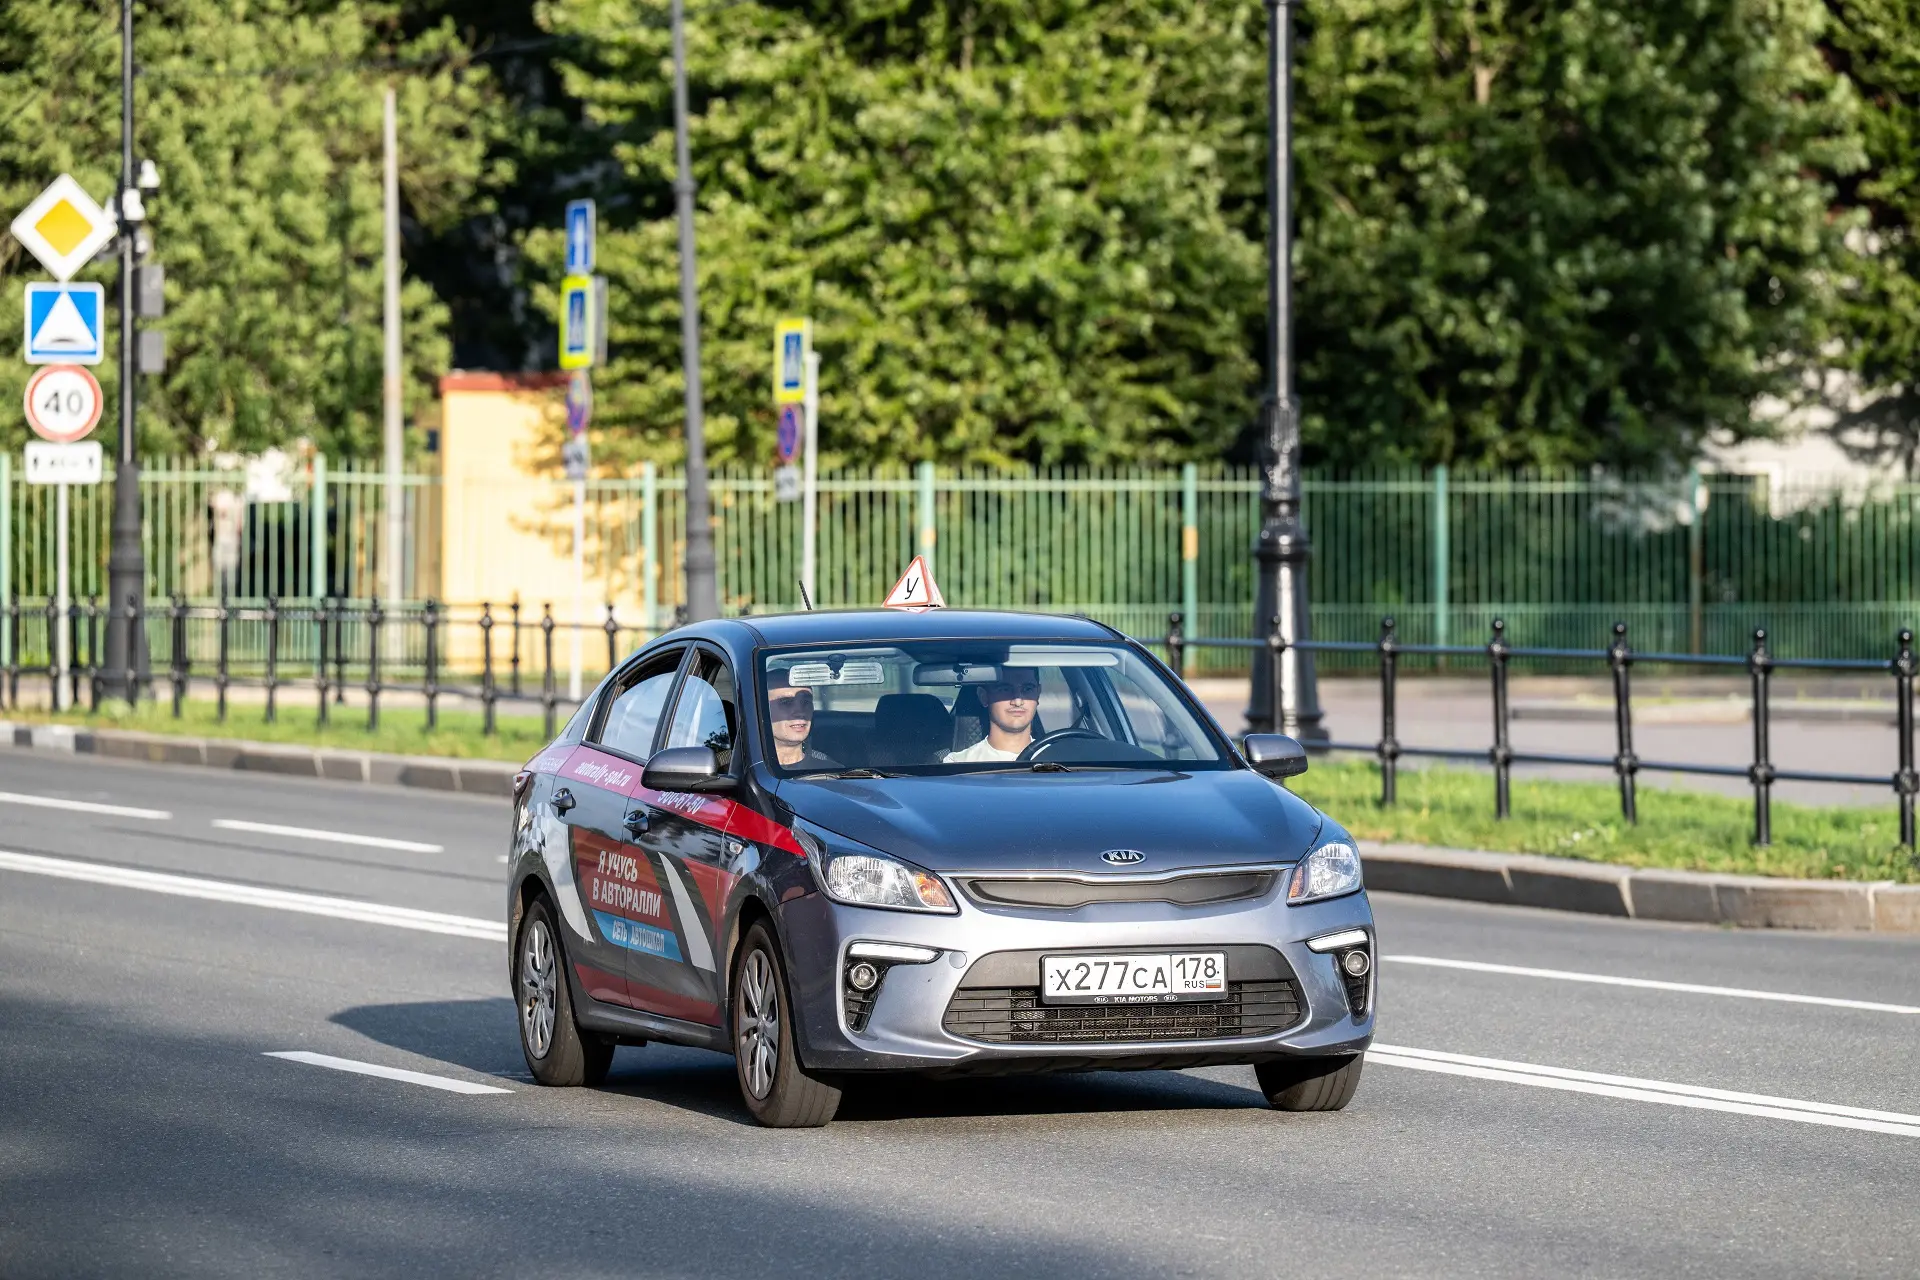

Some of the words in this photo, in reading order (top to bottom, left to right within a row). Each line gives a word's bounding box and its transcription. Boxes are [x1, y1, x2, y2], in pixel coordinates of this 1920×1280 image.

[44, 390, 83, 416] 40
[597, 850, 606, 874] Я
[606, 853, 638, 882] УЧУСЬ
[1107, 851, 1141, 861] KIA
[593, 877, 600, 901] В
[601, 880, 662, 918] АВТОРАЛЛИ
[612, 919, 628, 942] СЕТЬ
[630, 925, 665, 953] АВТОШКОЛ
[1175, 957, 1217, 980] 178
[1184, 980, 1205, 989] RUS
[1128, 995, 1158, 1003] MOTORS
